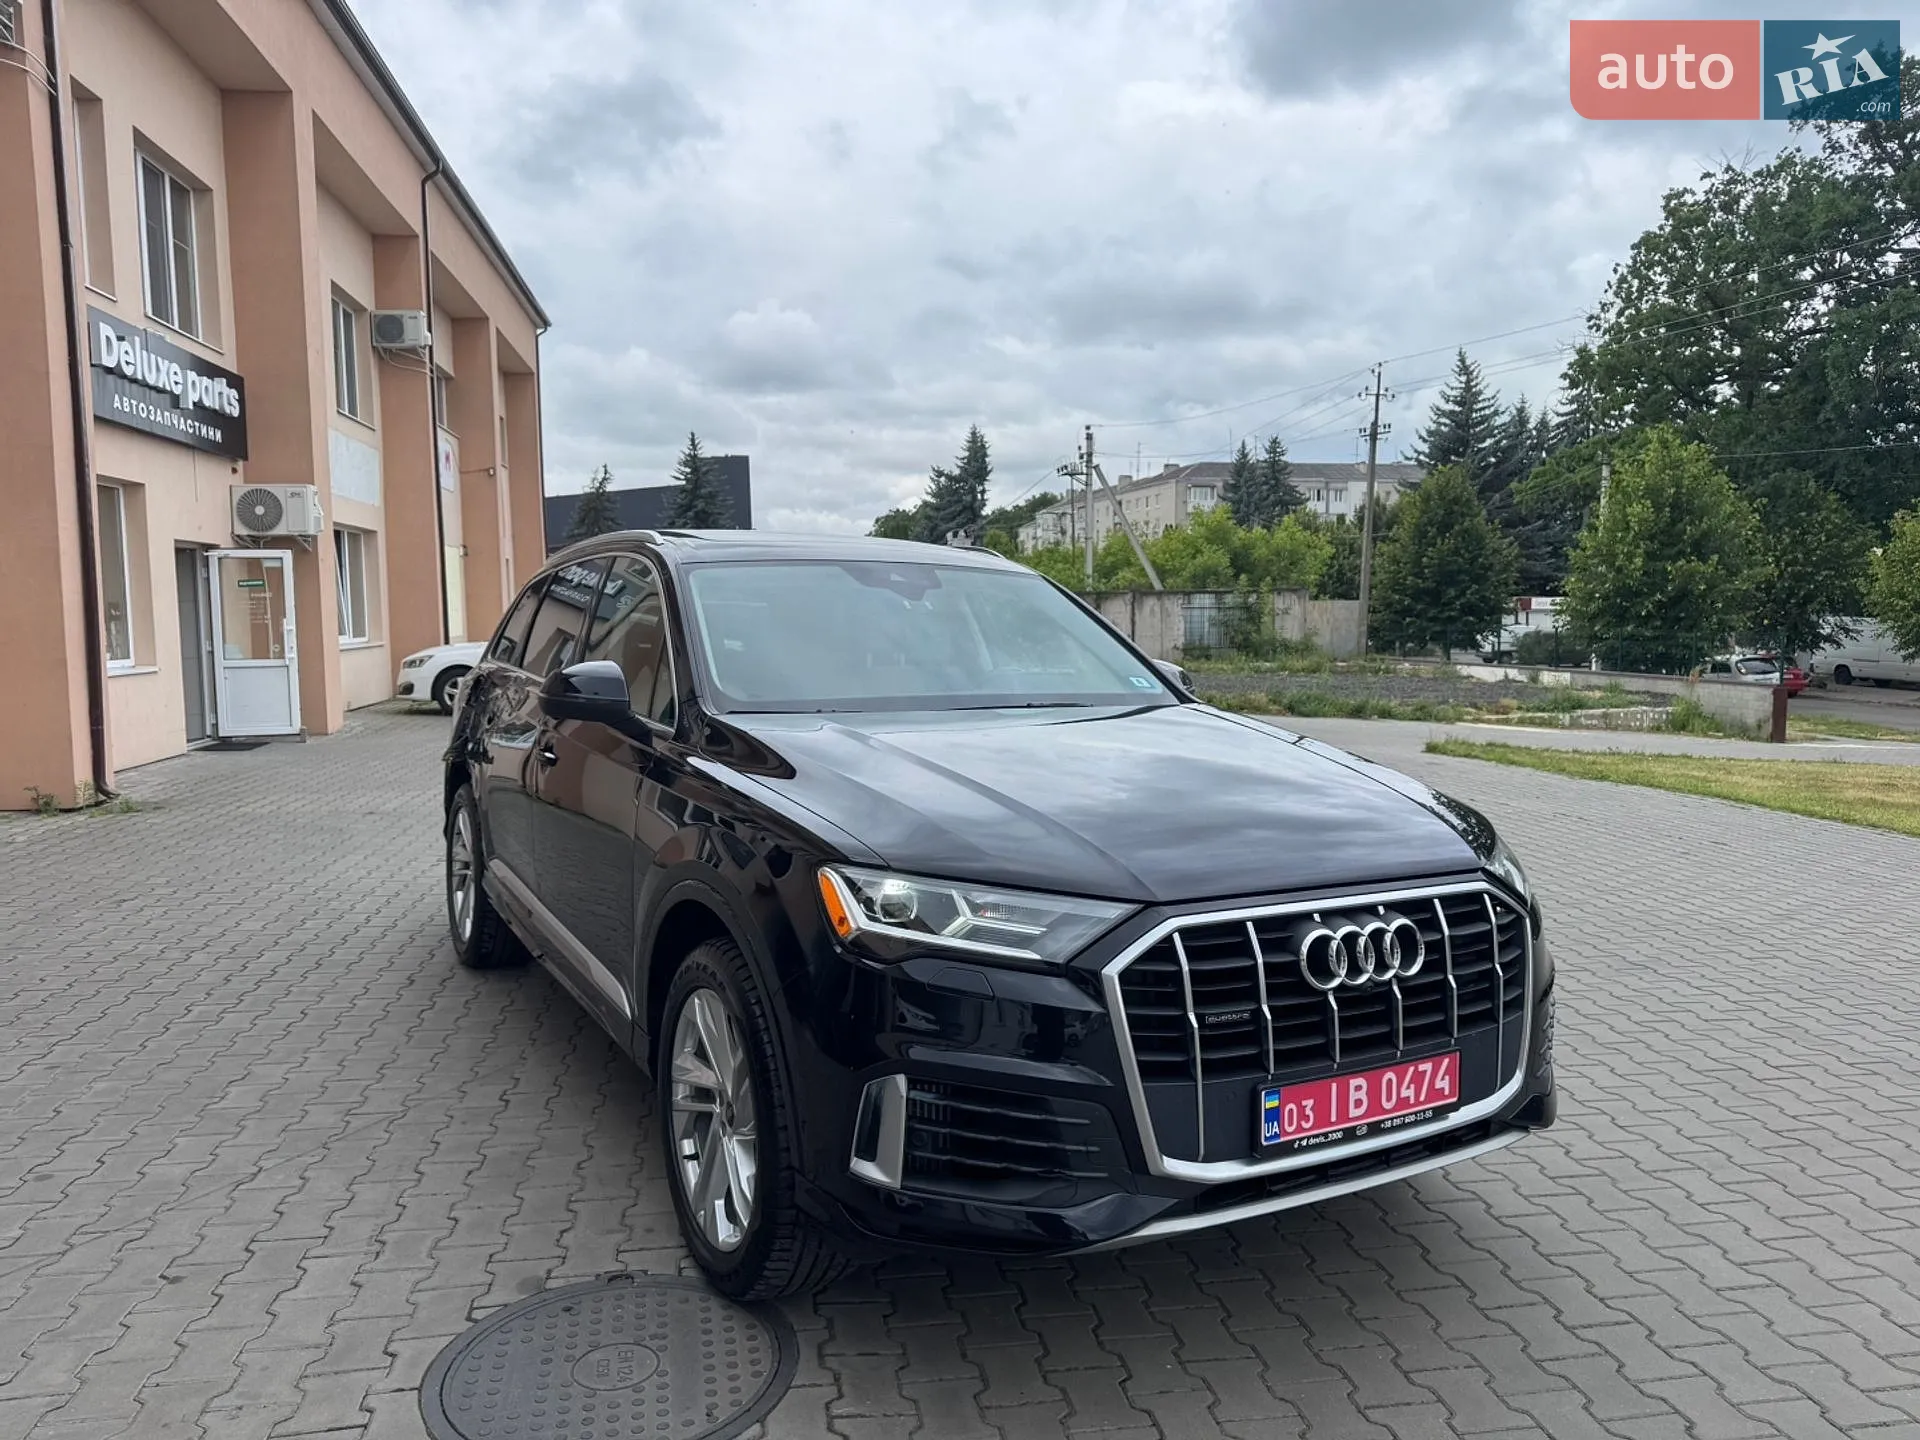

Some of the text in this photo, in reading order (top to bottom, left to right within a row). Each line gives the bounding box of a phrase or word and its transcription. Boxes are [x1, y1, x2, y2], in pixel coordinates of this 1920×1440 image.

[99, 322, 240, 417] Deluxe parts
[113, 393, 222, 443] АВТОЗАПЧАСТИНИ
[1284, 1057, 1450, 1133] 03 IB 0474
[1265, 1122, 1280, 1137] UA
